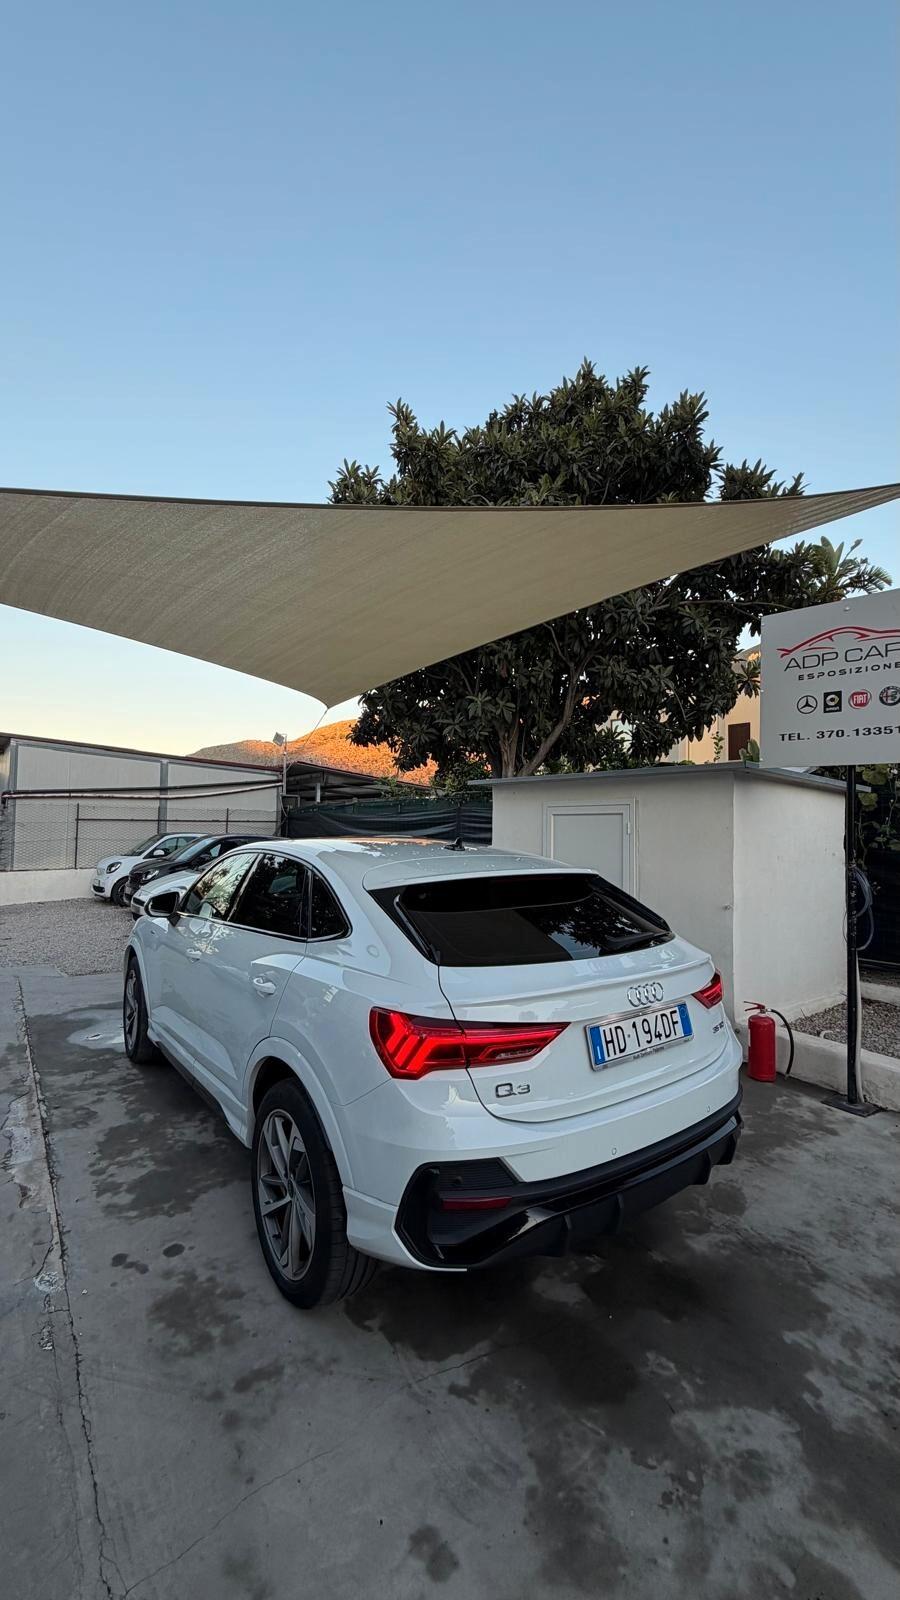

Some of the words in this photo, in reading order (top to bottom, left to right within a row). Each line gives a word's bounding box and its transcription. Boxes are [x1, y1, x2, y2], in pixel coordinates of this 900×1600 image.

[784, 651, 838, 671] ADP
[798, 661, 900, 681] ESPOSIZIONE
[853, 693, 867, 704] FIAT
[779, 732, 810, 742] TEL.
[495, 1082, 531, 1098] Q3
